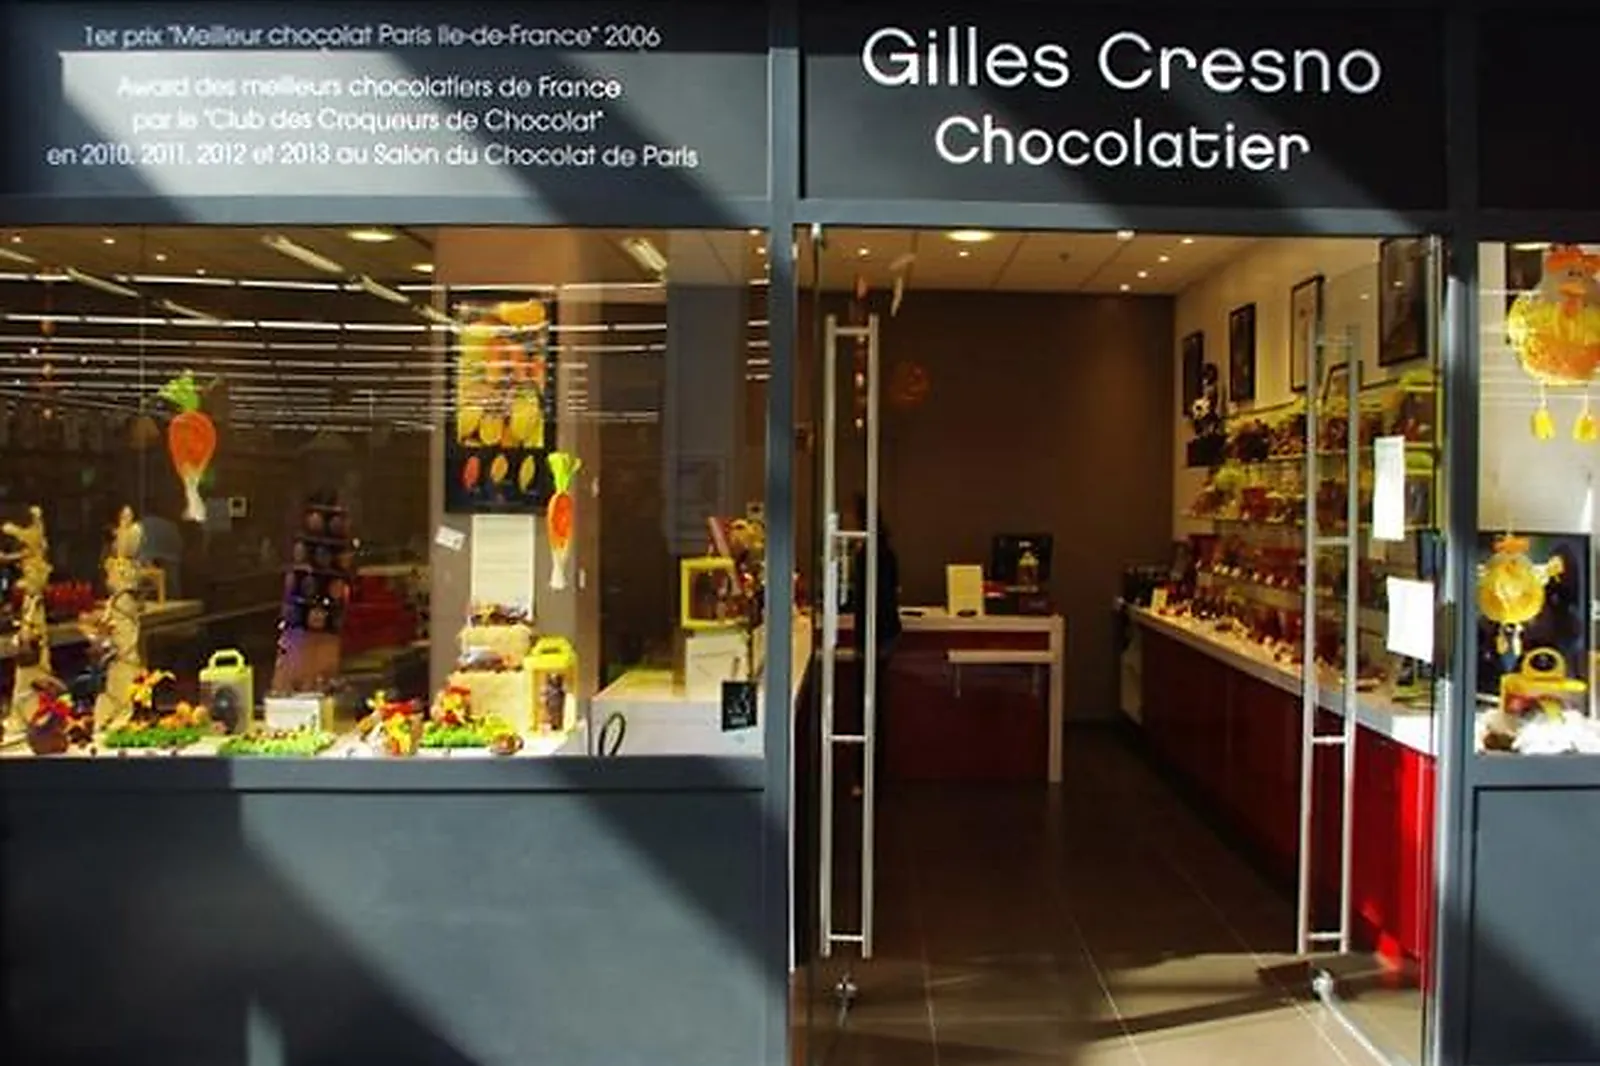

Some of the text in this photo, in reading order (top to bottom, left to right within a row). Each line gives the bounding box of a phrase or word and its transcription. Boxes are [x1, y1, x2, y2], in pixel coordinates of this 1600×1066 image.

[122, 25, 163, 49] prix
[268, 26, 373, 46] chocolat
[378, 24, 432, 46] Paris
[604, 25, 661, 47] 2006
[862, 26, 1382, 95] Gilles Cresno
[117, 75, 622, 98] Award des meilleurs chocolatiers de France
[133, 111, 172, 134] par
[177, 106, 198, 129] le
[270, 109, 312, 130] des
[318, 107, 440, 135] Croqueurs
[446, 110, 479, 131] de
[47, 146, 78, 165] en
[197, 142, 247, 165] 2012
[252, 144, 274, 165] et
[279, 142, 330, 165] 2013
[336, 146, 369, 165] au
[373, 142, 440, 166] Salon
[446, 143, 479, 166] du
[484, 143, 596, 167] Chocolat
[602, 145, 637, 167] de
[643, 145, 699, 168] Paris
[935, 114, 1311, 171] Chocolatier
